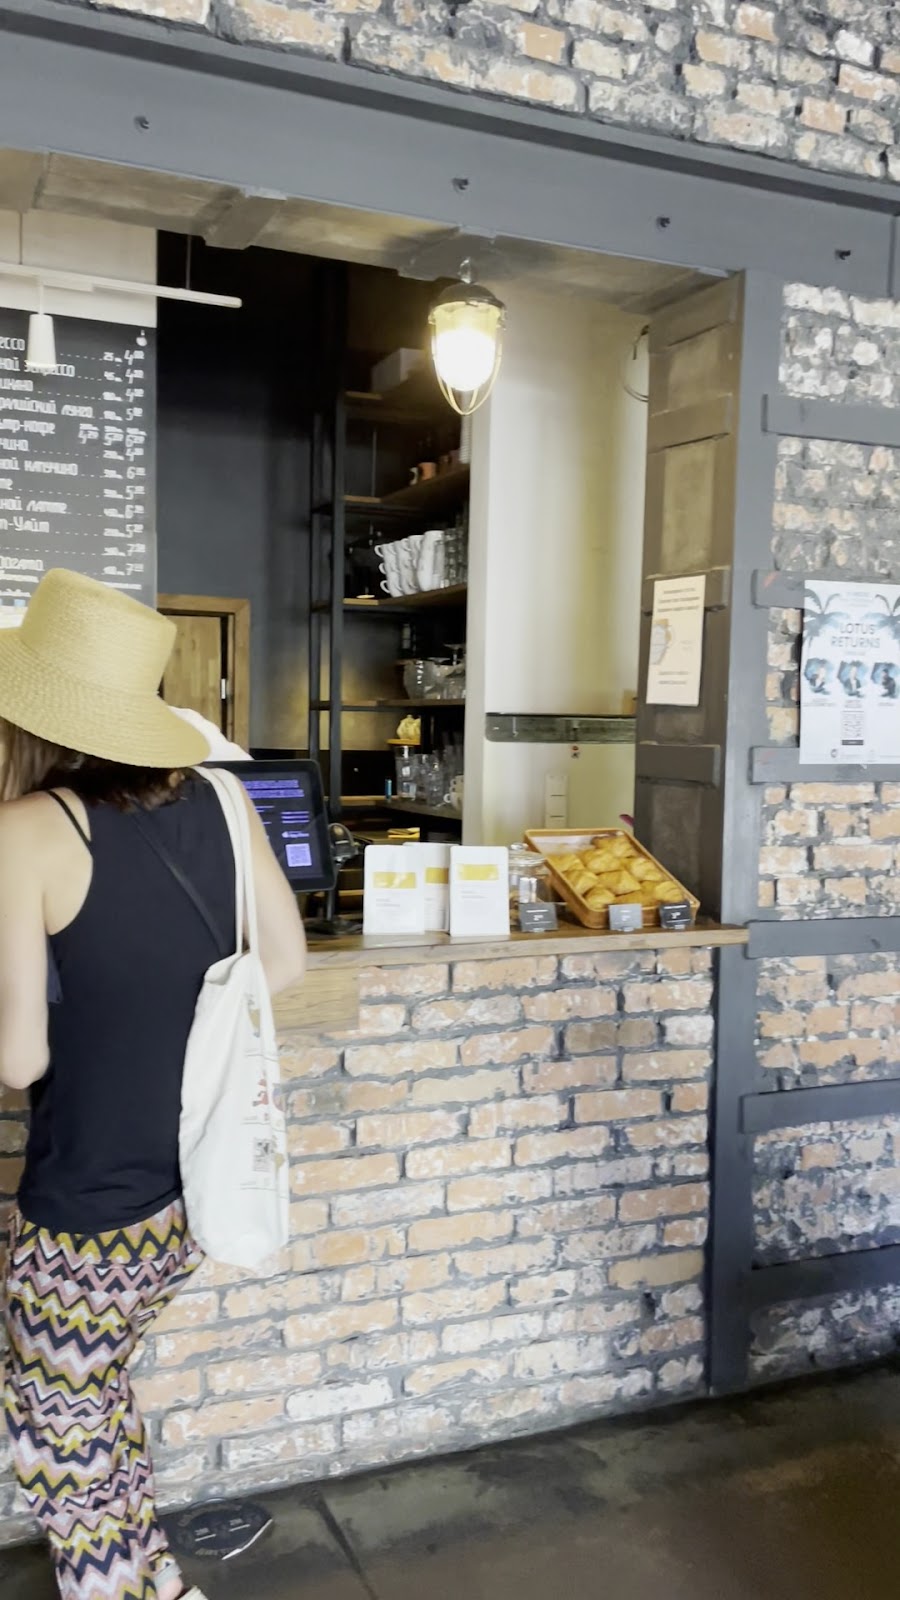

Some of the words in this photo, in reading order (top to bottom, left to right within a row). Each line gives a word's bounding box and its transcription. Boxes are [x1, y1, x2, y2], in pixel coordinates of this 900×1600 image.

[24, 460, 78, 476] капучино
[839, 622, 876, 635] LOTUS
[830, 636, 881, 649] RETURNS
